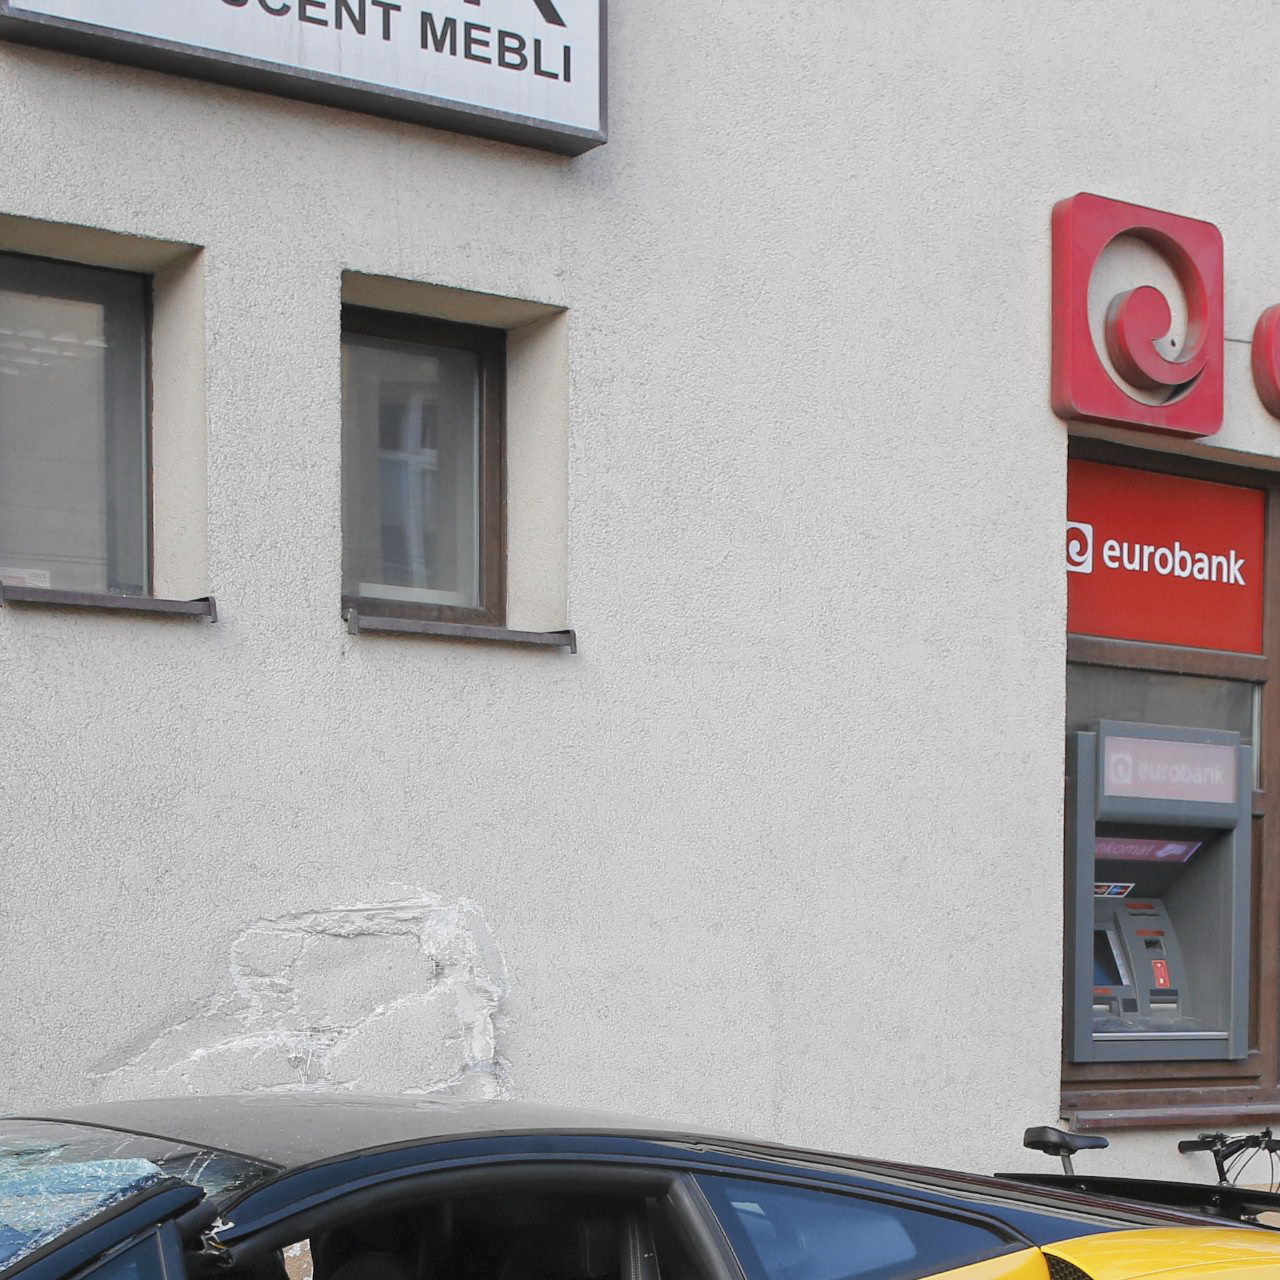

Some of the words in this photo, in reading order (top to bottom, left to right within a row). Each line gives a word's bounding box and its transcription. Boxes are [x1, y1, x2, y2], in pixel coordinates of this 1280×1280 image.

[420, 11, 571, 82] MEBLI
[1102, 539, 1246, 586] eurobank
[1137, 761, 1225, 785] eurobank
